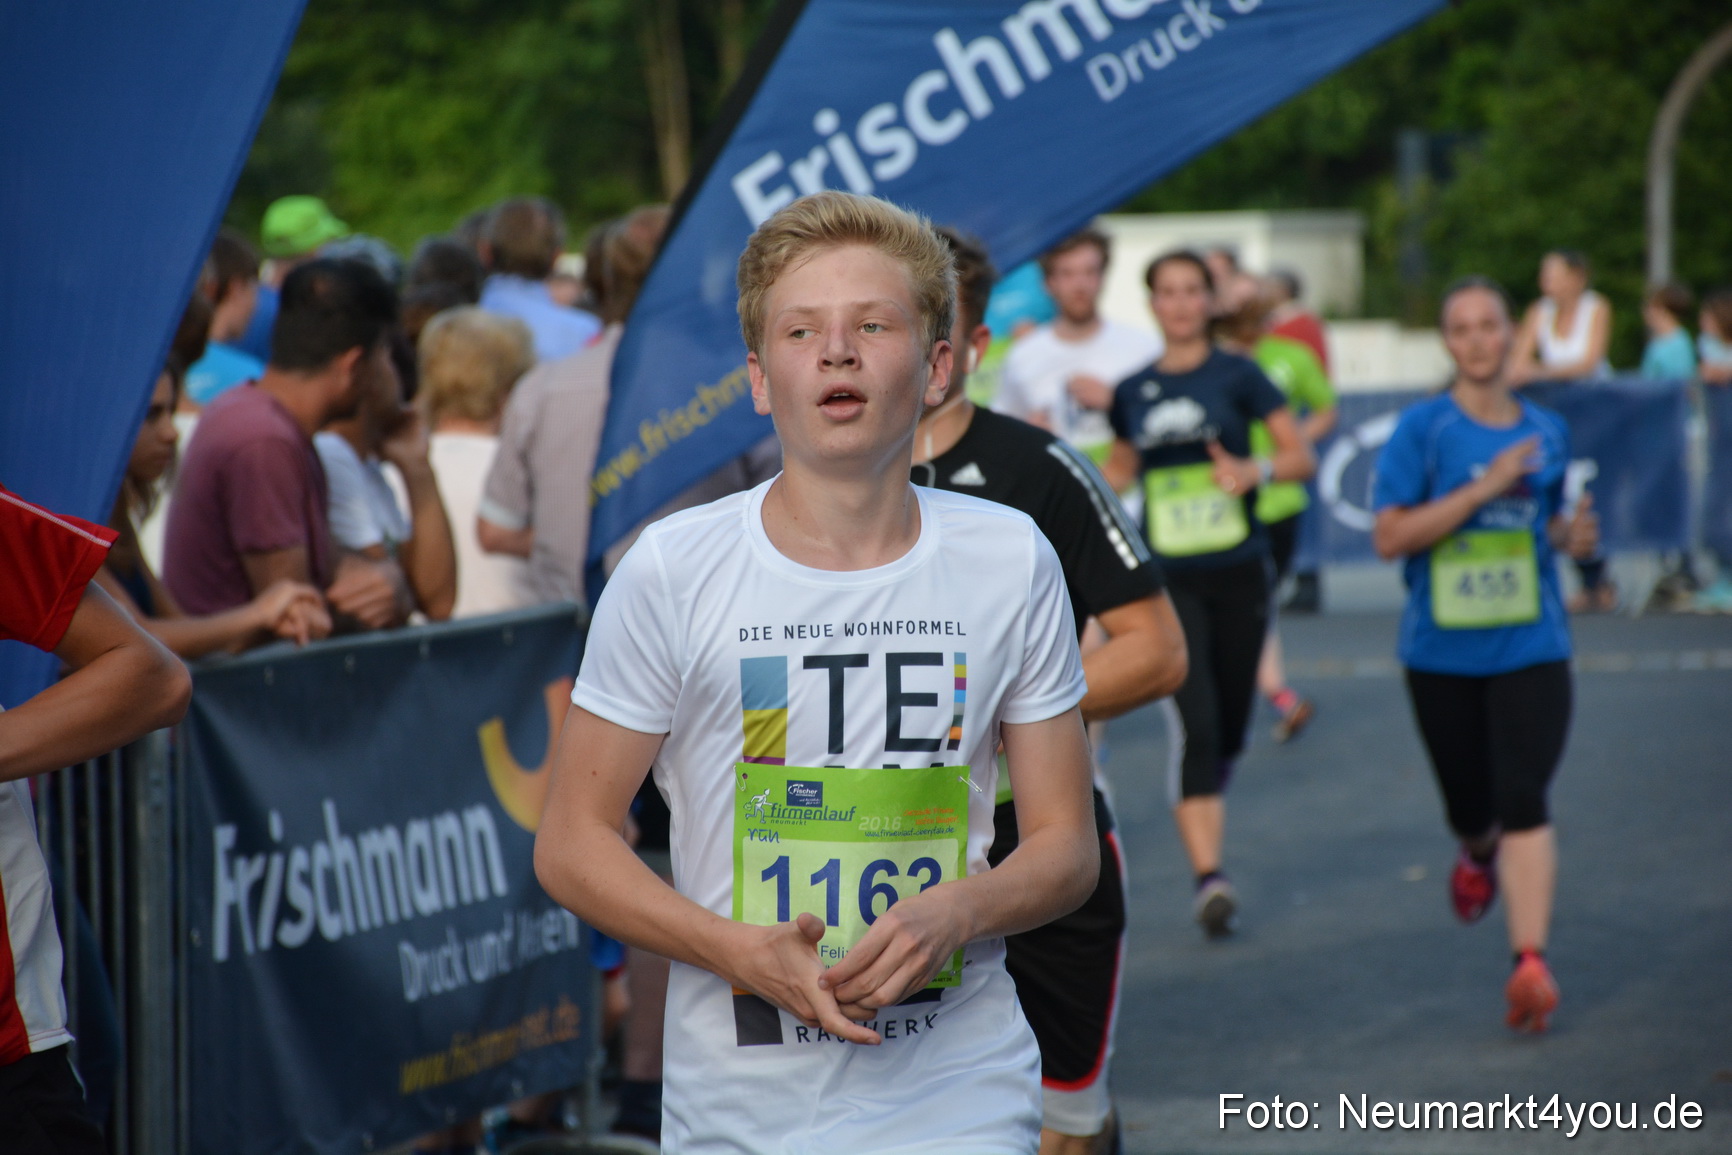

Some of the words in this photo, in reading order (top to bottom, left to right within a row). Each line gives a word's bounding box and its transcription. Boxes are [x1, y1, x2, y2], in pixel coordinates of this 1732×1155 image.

[1085, 0, 1228, 102] Druck
[739, 626, 773, 642] DIE
[784, 623, 834, 640] NEUE
[844, 620, 967, 637] WOHNFORMEL
[770, 802, 857, 822] firmenlauf
[770, 818, 807, 826] neumarkt
[858, 816, 902, 832] 2016
[211, 797, 508, 963] Frischmann
[820, 945, 849, 959] Feli
[399, 924, 469, 1003] Druck
